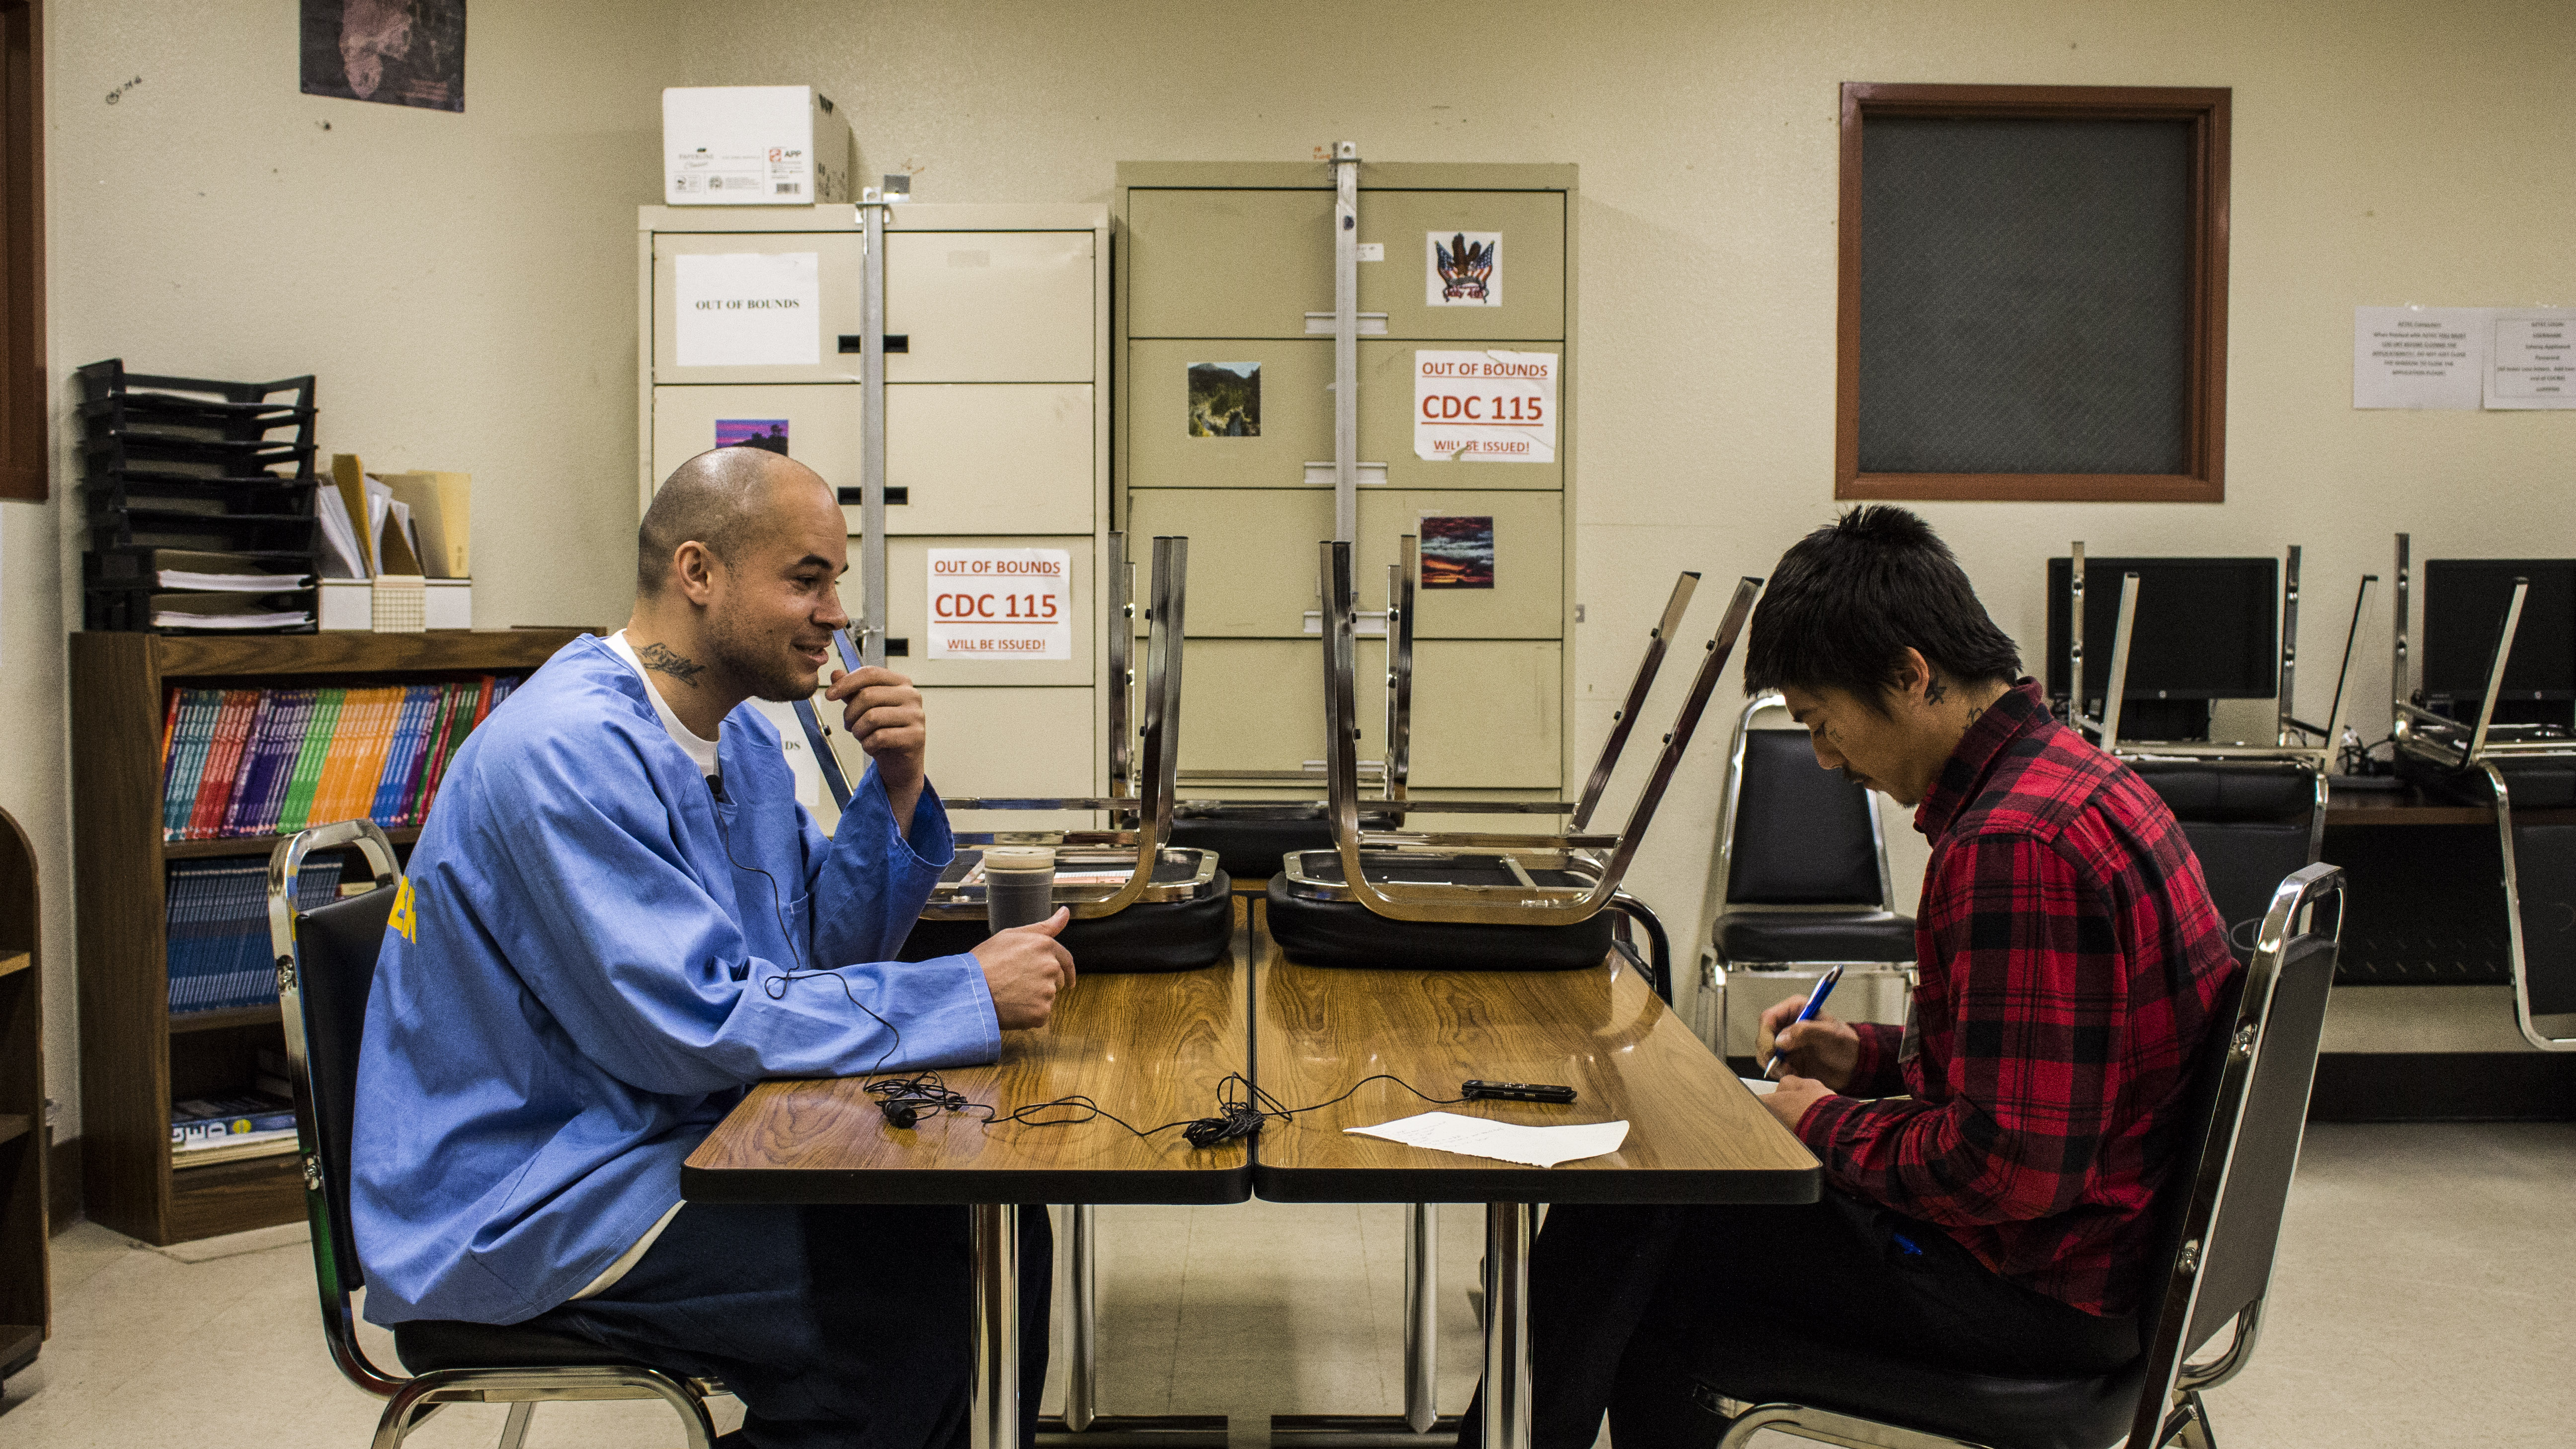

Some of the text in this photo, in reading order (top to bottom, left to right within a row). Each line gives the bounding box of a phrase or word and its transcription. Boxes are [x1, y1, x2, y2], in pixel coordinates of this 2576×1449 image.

[696, 299, 800, 310] OUT OF BOUNDS
[1422, 362, 1548, 377] OUT OF BOUNDS
[1422, 395, 1542, 420] CDC 115
[1466, 441, 1479, 451] BE
[1483, 441, 1530, 452] ISSUED!
[935, 561, 1061, 574] OUT OF BOUNDS
[935, 593, 1057, 618] CDC 115
[947, 639, 1046, 650] WILL BE ISSUED!
